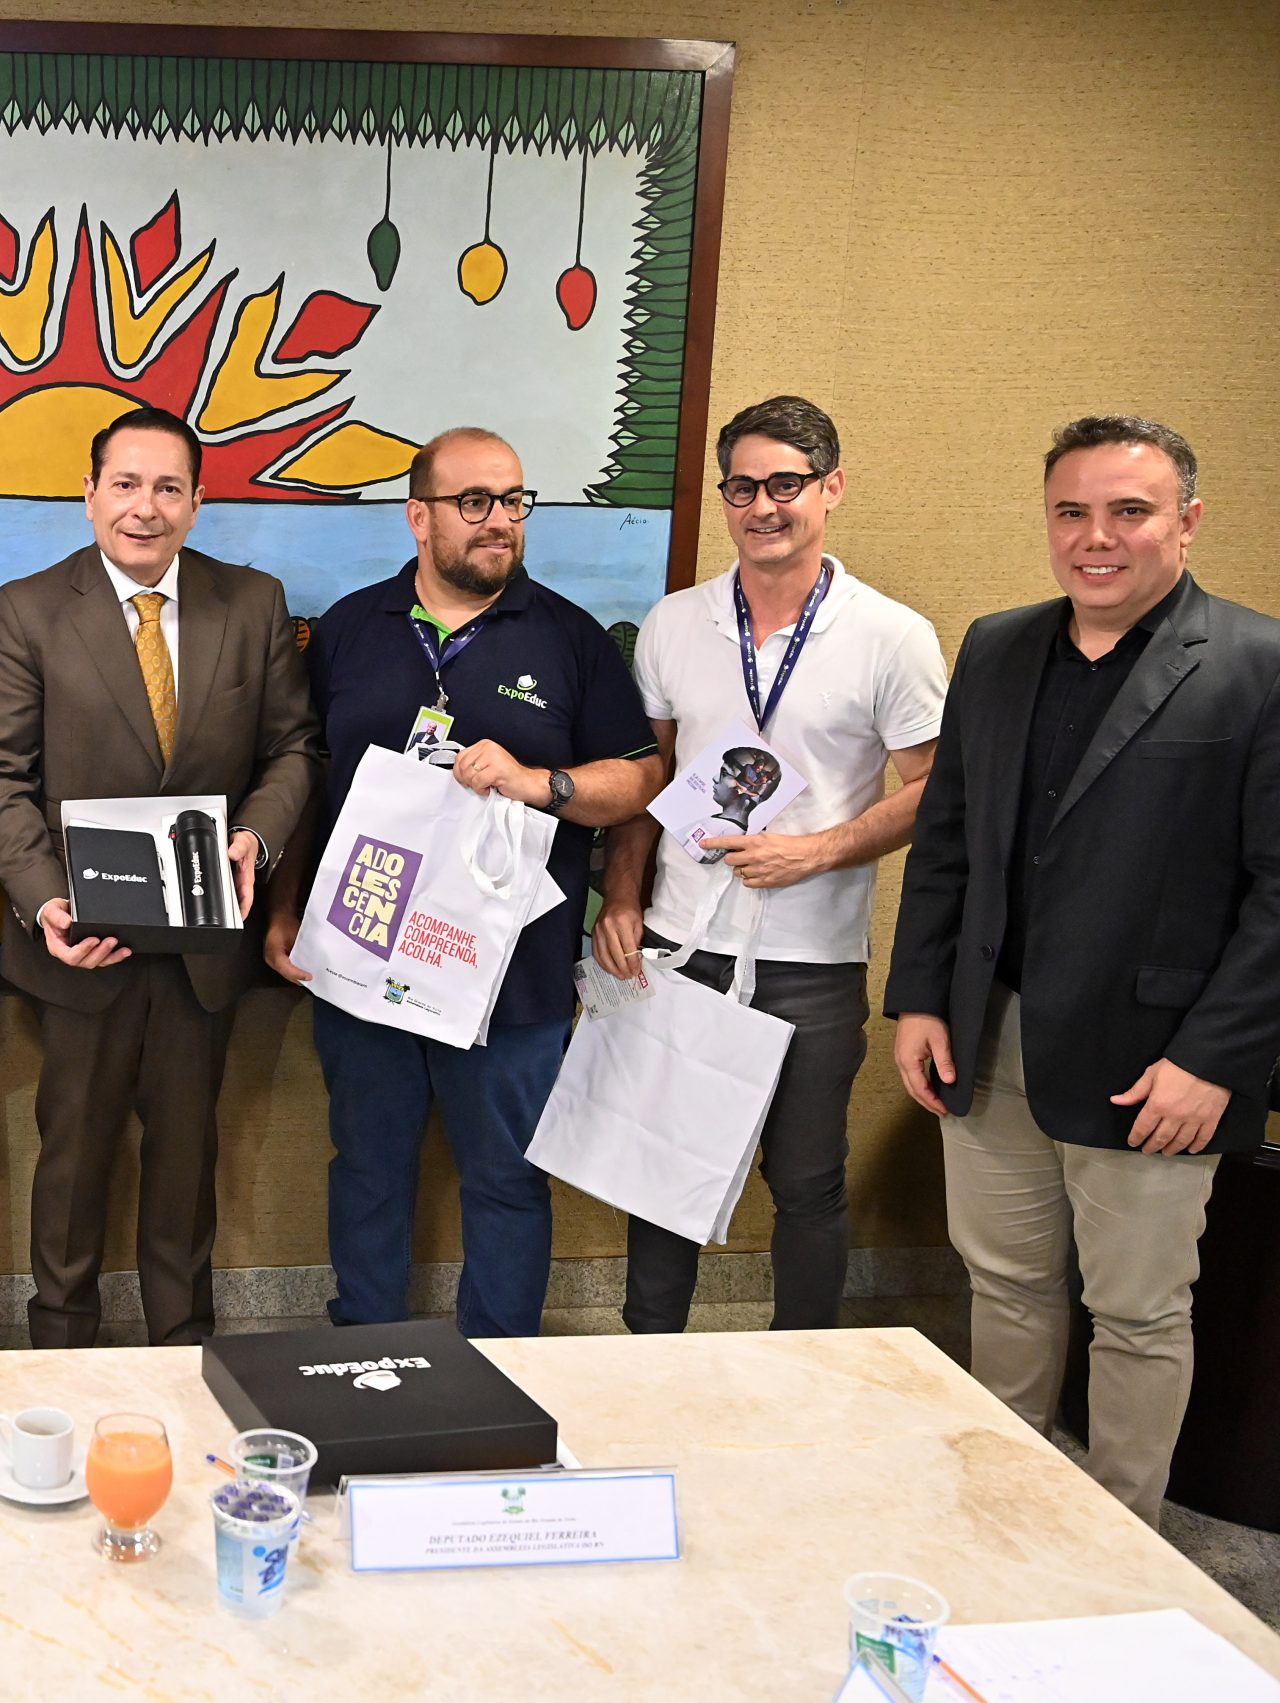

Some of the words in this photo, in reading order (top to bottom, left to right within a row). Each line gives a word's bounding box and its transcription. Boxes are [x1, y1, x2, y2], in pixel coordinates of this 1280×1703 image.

[497, 684, 548, 709] ExpoEduc
[191, 851, 202, 883] ExpoEduc
[356, 843, 405, 877] ADO
[101, 872, 148, 883] ExpoEduc
[348, 864, 401, 901] LES
[342, 886, 396, 924] CÊN
[348, 912, 388, 947] CIA
[398, 940, 442, 968] ACOLHA.
[298, 1357, 431, 1376] ExpoEduc
